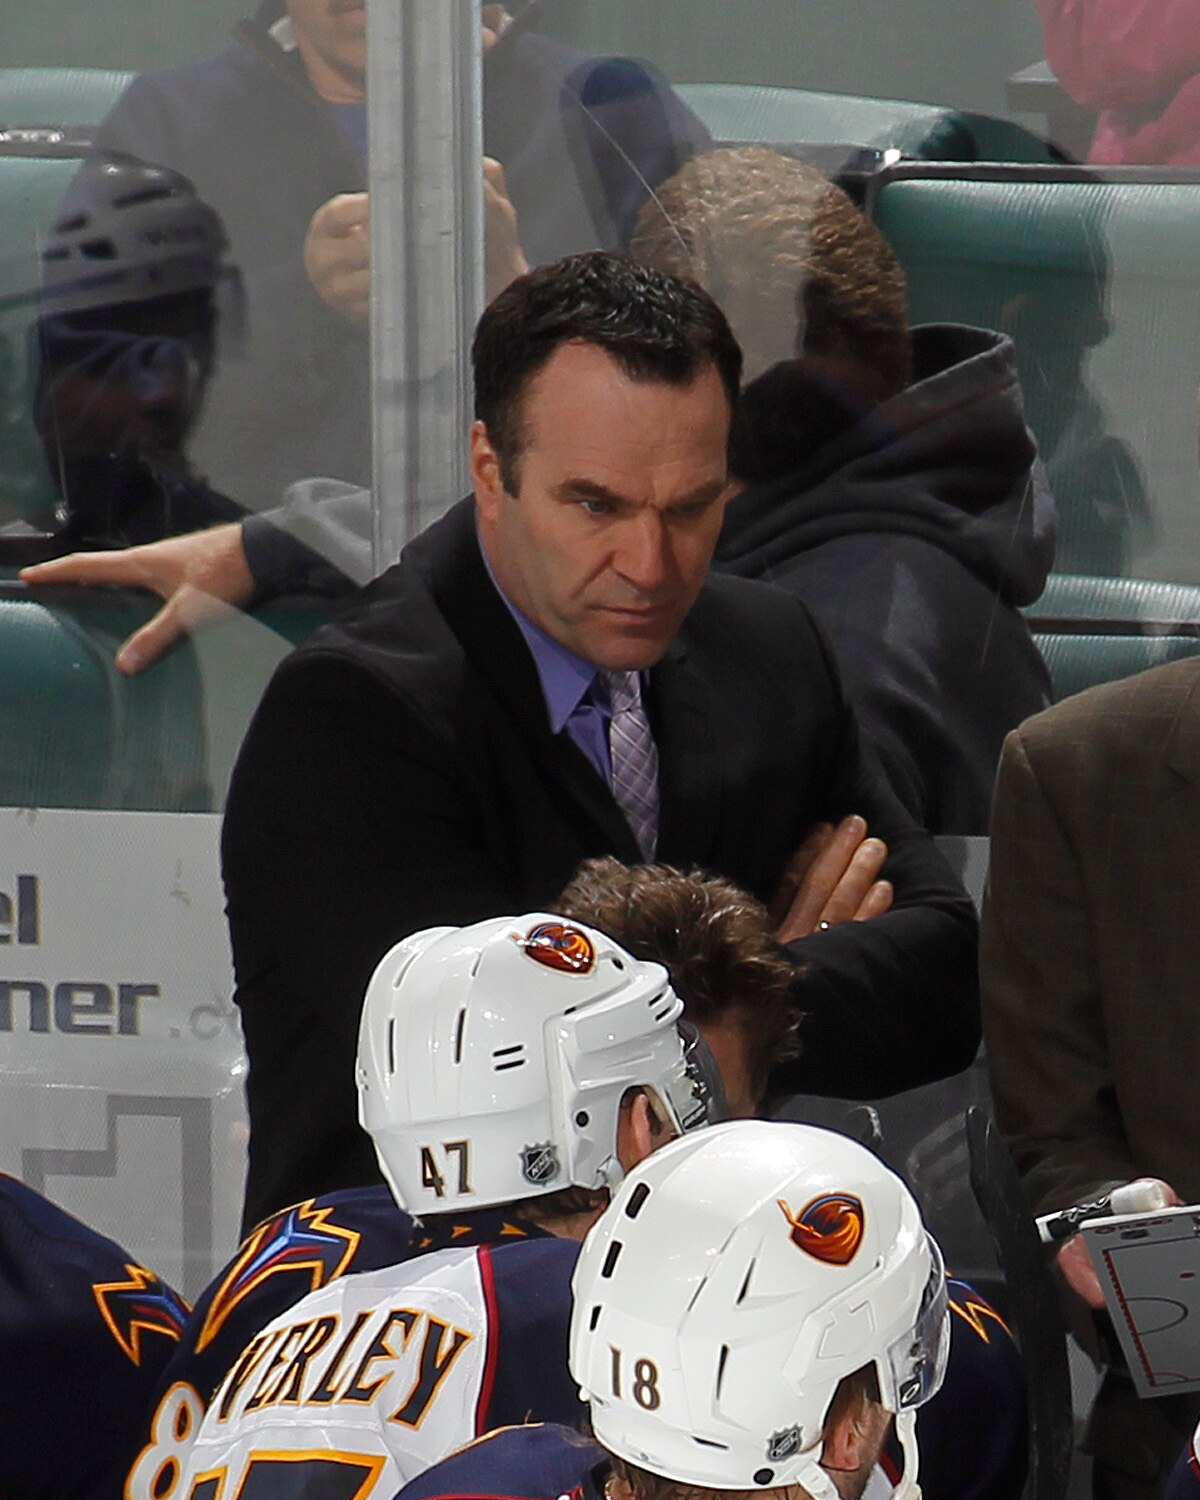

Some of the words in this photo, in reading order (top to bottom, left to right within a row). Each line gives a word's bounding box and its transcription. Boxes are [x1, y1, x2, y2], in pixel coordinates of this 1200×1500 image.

[0, 875, 40, 945] l
[420, 1139, 472, 1198] 47
[608, 1343, 662, 1412] 18
